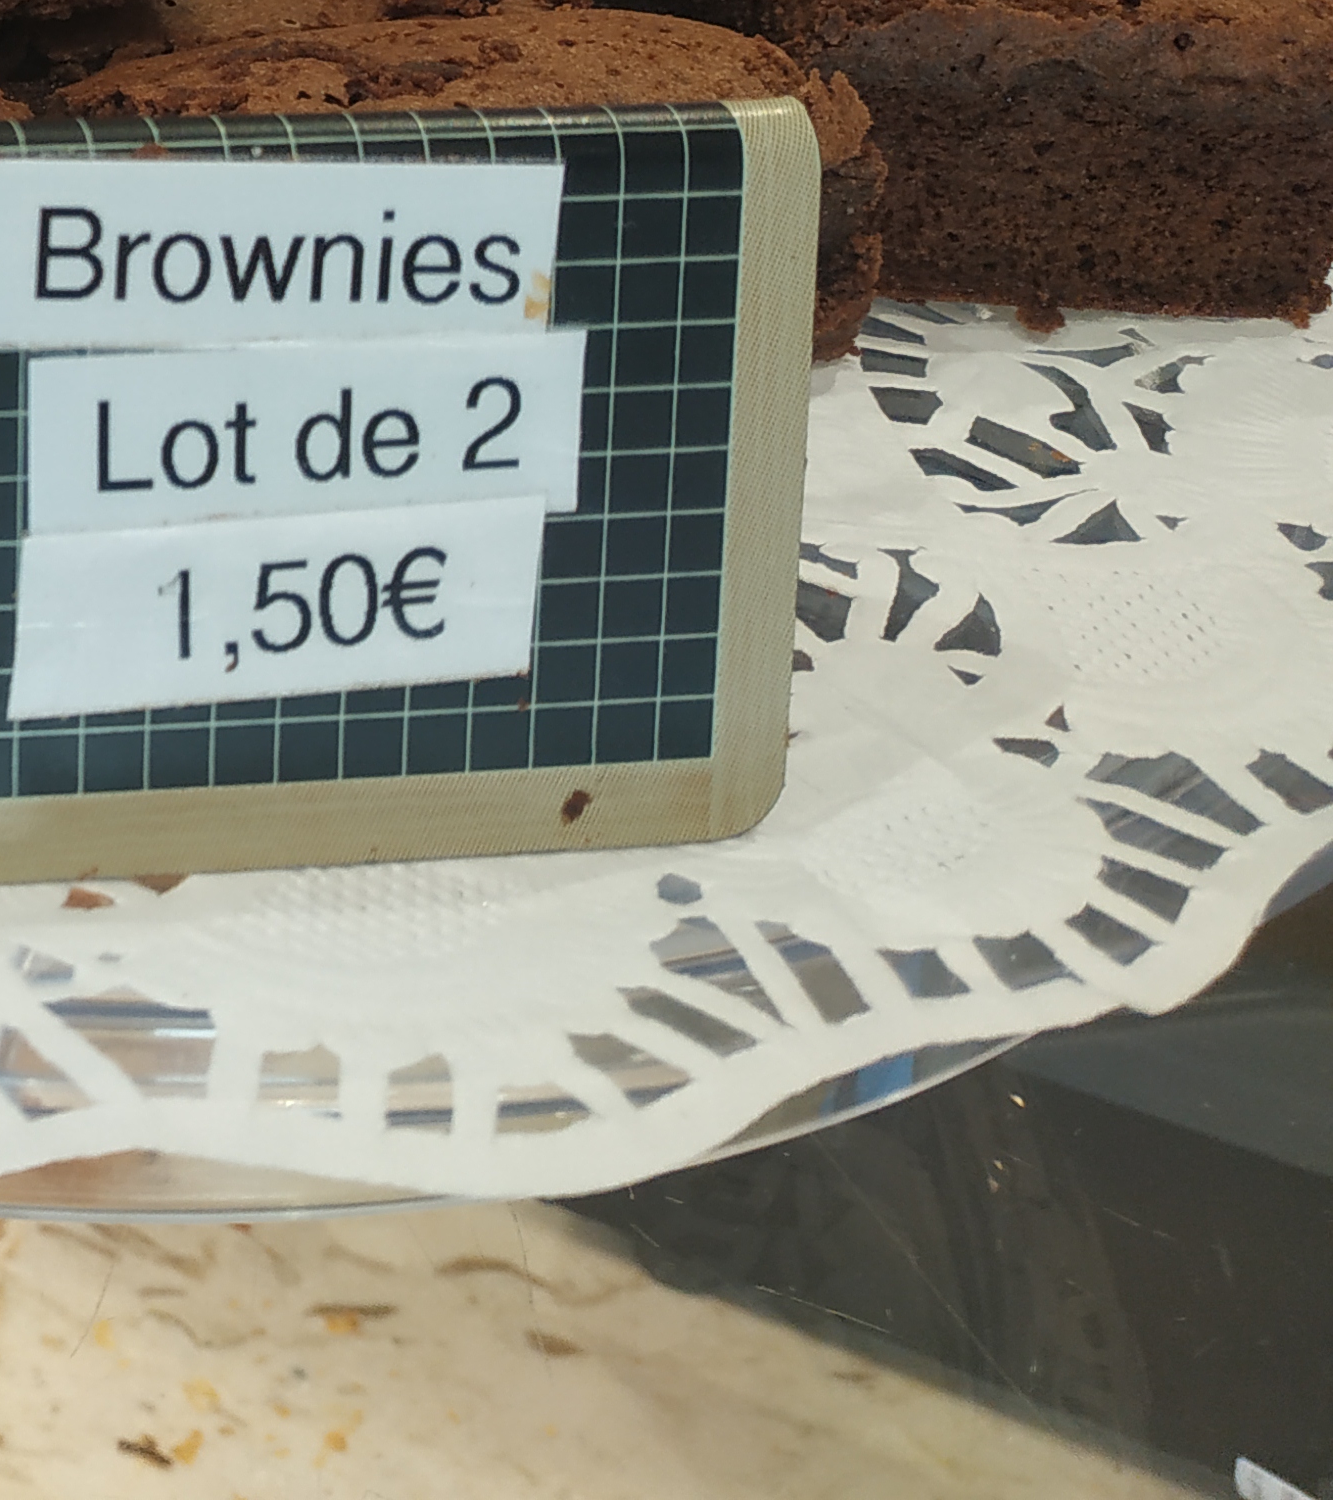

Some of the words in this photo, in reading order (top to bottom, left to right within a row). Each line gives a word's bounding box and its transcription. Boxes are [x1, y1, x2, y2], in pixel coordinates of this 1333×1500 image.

[34, 206, 521, 304] Brownies
[96, 399, 257, 492] Lot
[295, 387, 420, 482] de
[462, 376, 523, 472] 2
[158, 545, 447, 674] 1,50€
